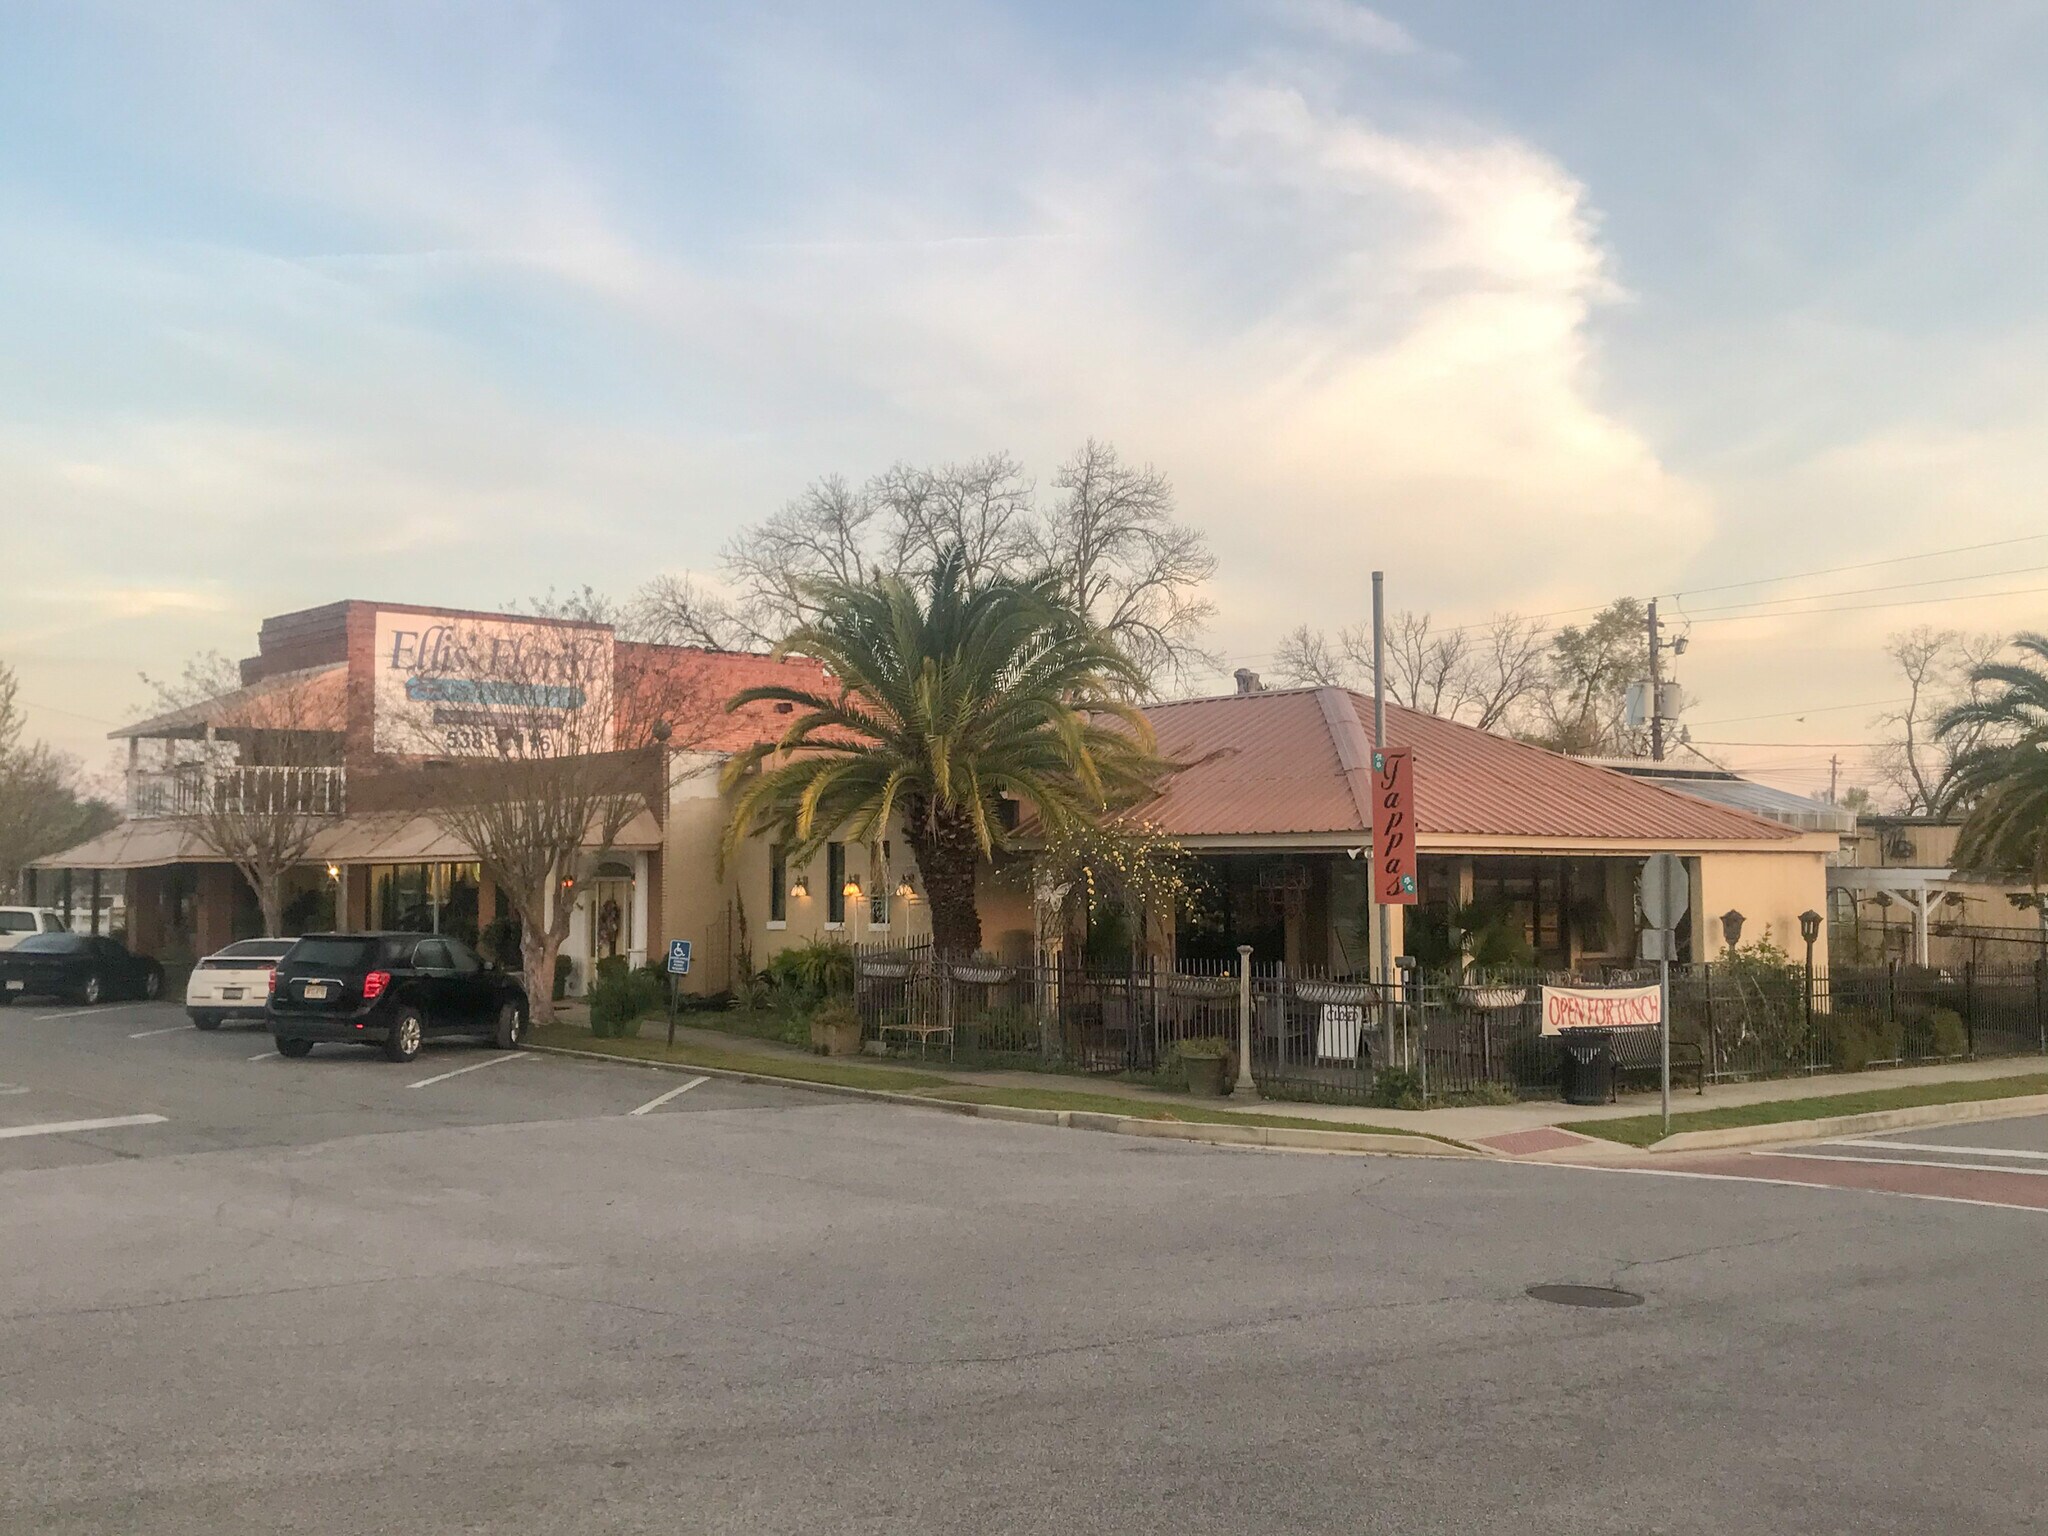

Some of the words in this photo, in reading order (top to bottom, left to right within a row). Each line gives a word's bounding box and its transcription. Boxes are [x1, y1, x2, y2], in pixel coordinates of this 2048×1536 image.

[1381, 753, 1406, 897] Tappas
[1549, 996, 1584, 1025] OPEN
[1587, 998, 1614, 1025] FOR
[1617, 995, 1658, 1024] LUNCH
